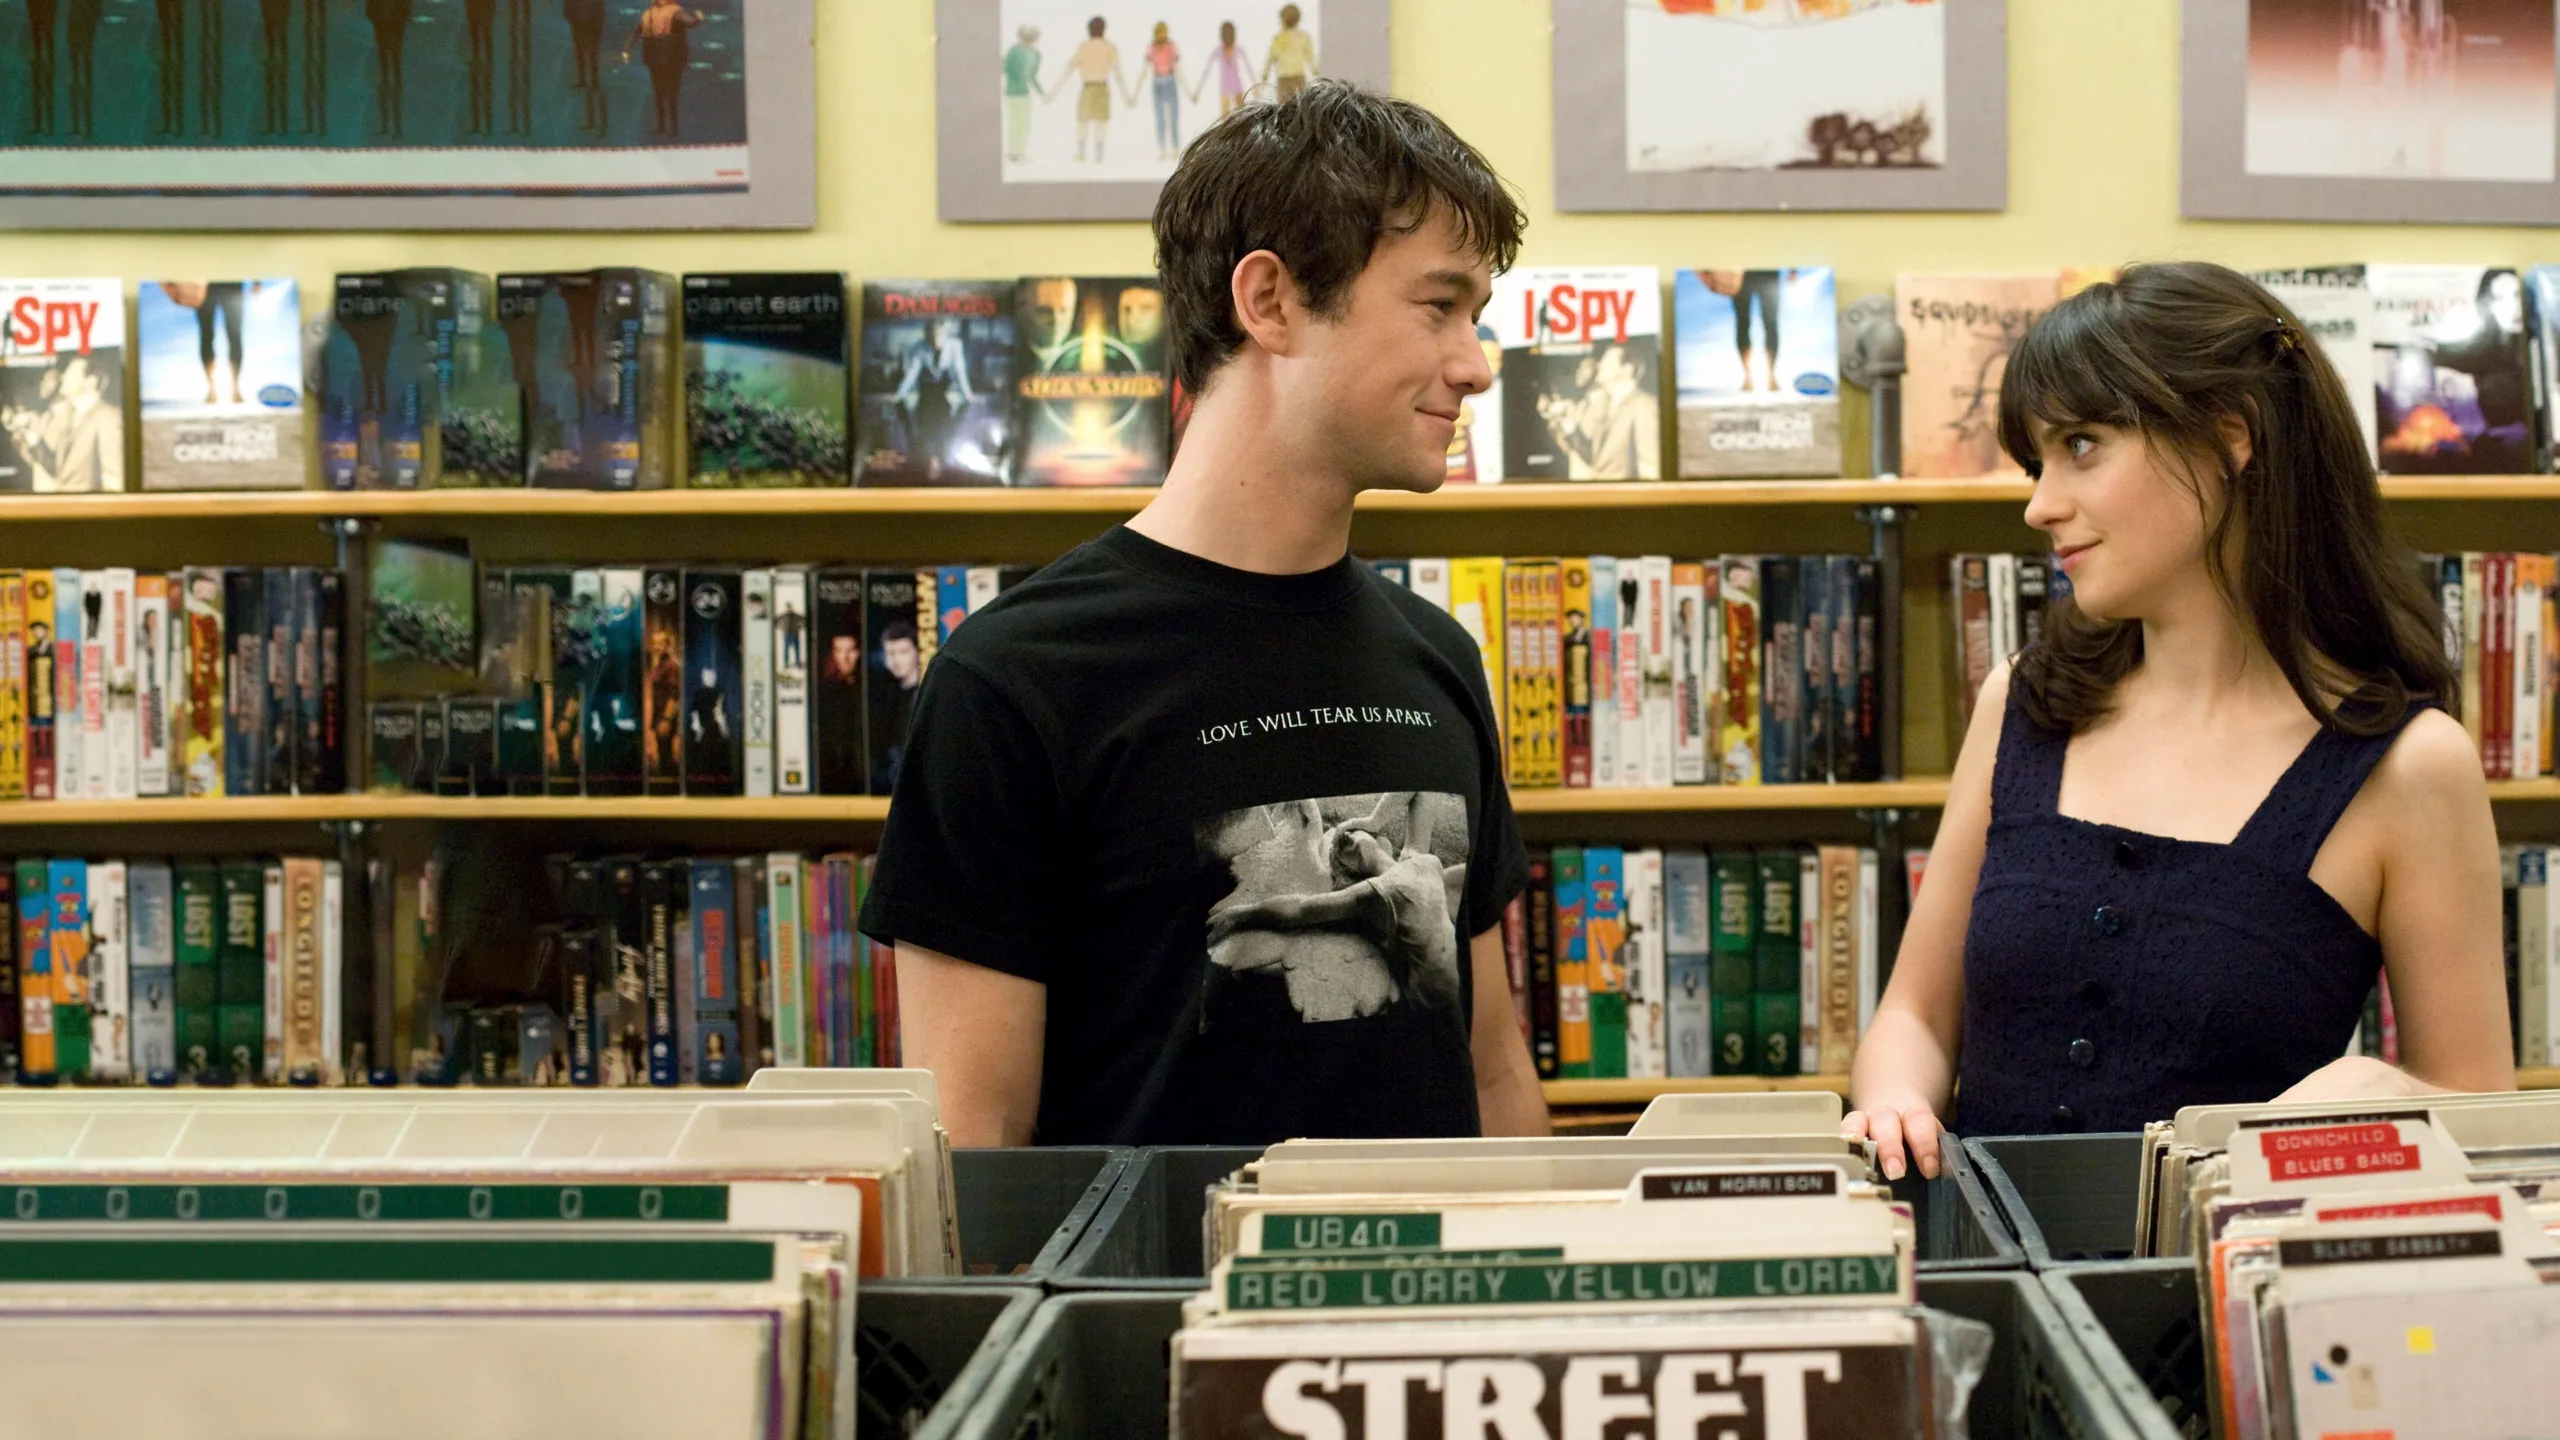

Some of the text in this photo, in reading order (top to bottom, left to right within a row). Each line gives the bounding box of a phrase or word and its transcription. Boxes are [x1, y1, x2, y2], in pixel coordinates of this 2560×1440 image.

[13, 296, 99, 356] SPY
[684, 292, 840, 321] planet earth
[1524, 284, 1635, 343] I SPY
[1201, 707, 1432, 744] LOVE WILL TEAR US APART
[184, 893, 214, 949] LOST
[227, 892, 258, 949] LOST
[1720, 882, 1748, 938] LOST
[1763, 881, 1793, 937] LOST
[1832, 863, 1853, 1021] LONGITUDE
[2275, 1129, 2386, 1151] DOWNCHILD
[2283, 1151, 2405, 1175] BLUES BAND
[1670, 1177, 1823, 1194] VAN MORRISON
[1293, 1217, 1399, 1250] UB40
[2311, 1235, 2472, 1261] BLACK SABBATH
[1238, 1257, 1897, 1307] RED LORRY YELLOW LORRY
[1262, 1352, 1843, 1440] STREET
